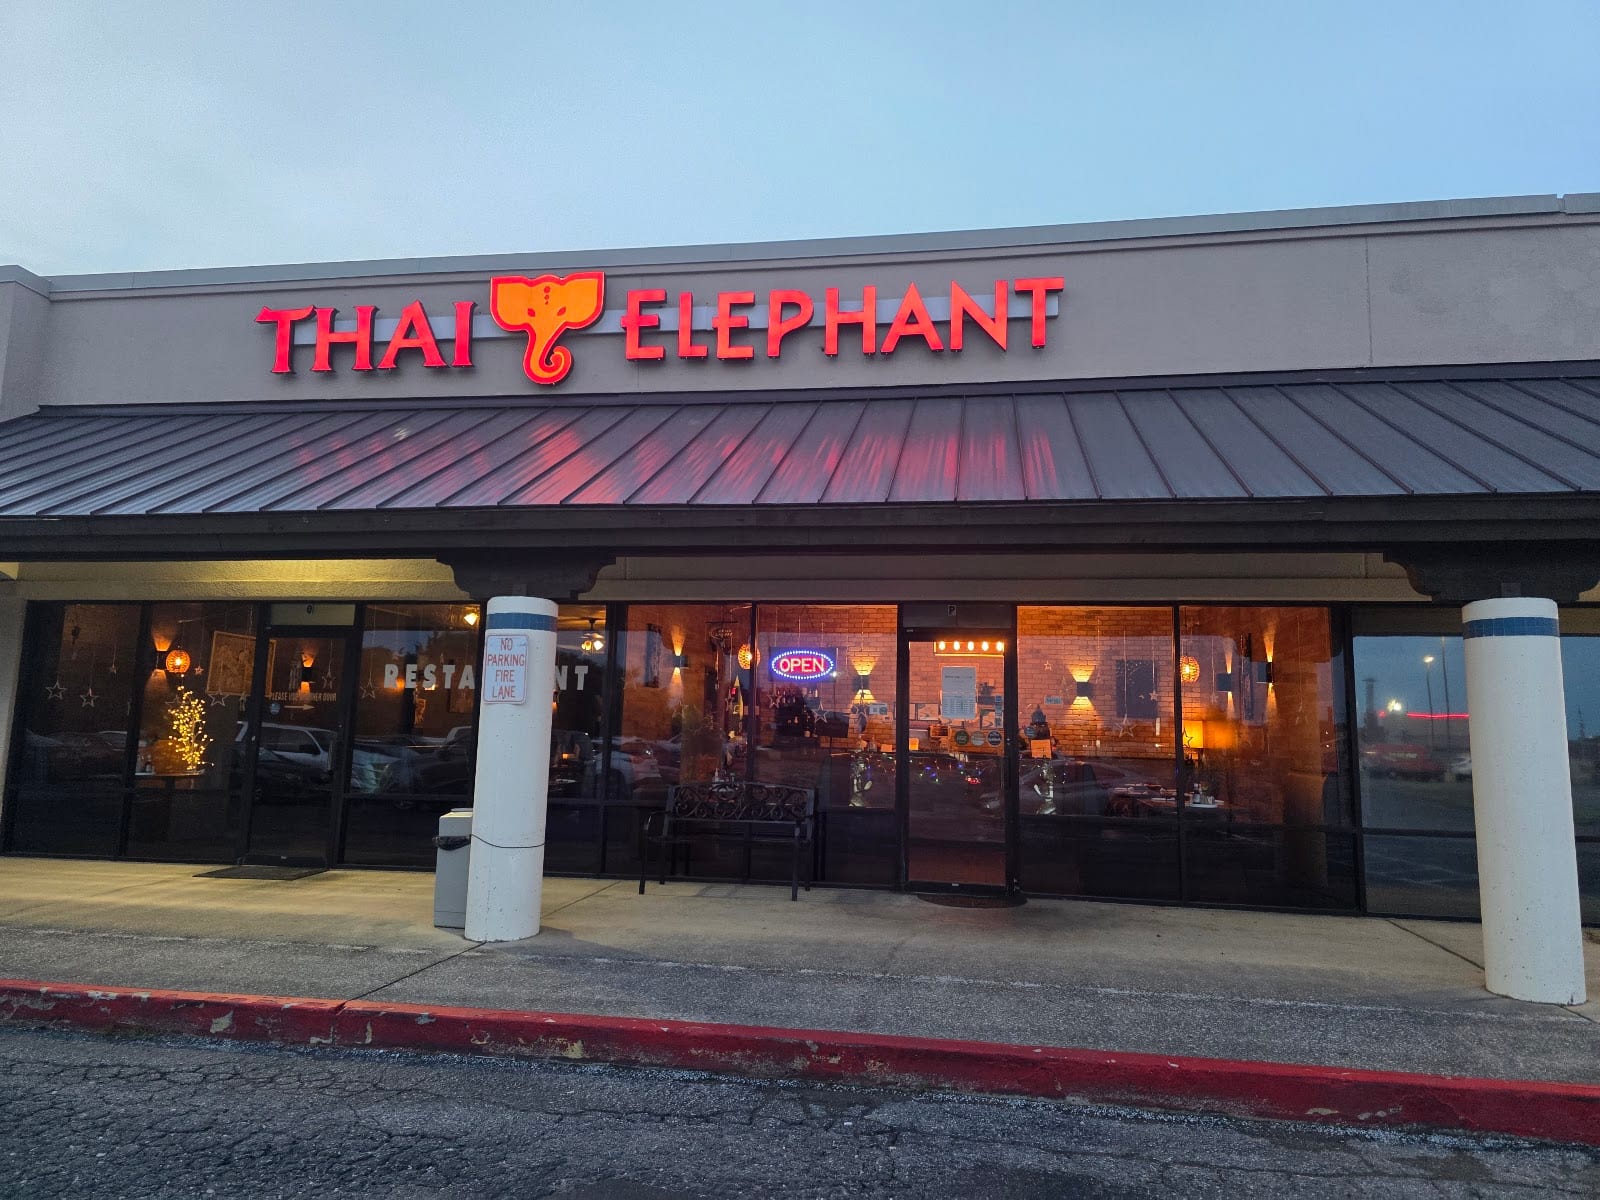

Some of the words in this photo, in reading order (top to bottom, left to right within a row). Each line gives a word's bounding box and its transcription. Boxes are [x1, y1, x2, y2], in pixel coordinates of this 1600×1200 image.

[254, 299, 476, 374] THAI
[621, 276, 1065, 361] ELEPHANT
[500, 637, 514, 651] NO
[487, 653, 526, 667] PARKING
[778, 657, 825, 673] OPEN
[384, 663, 589, 690] RESTANT
[495, 669, 516, 682] FIRE
[492, 685, 517, 698] LANE
